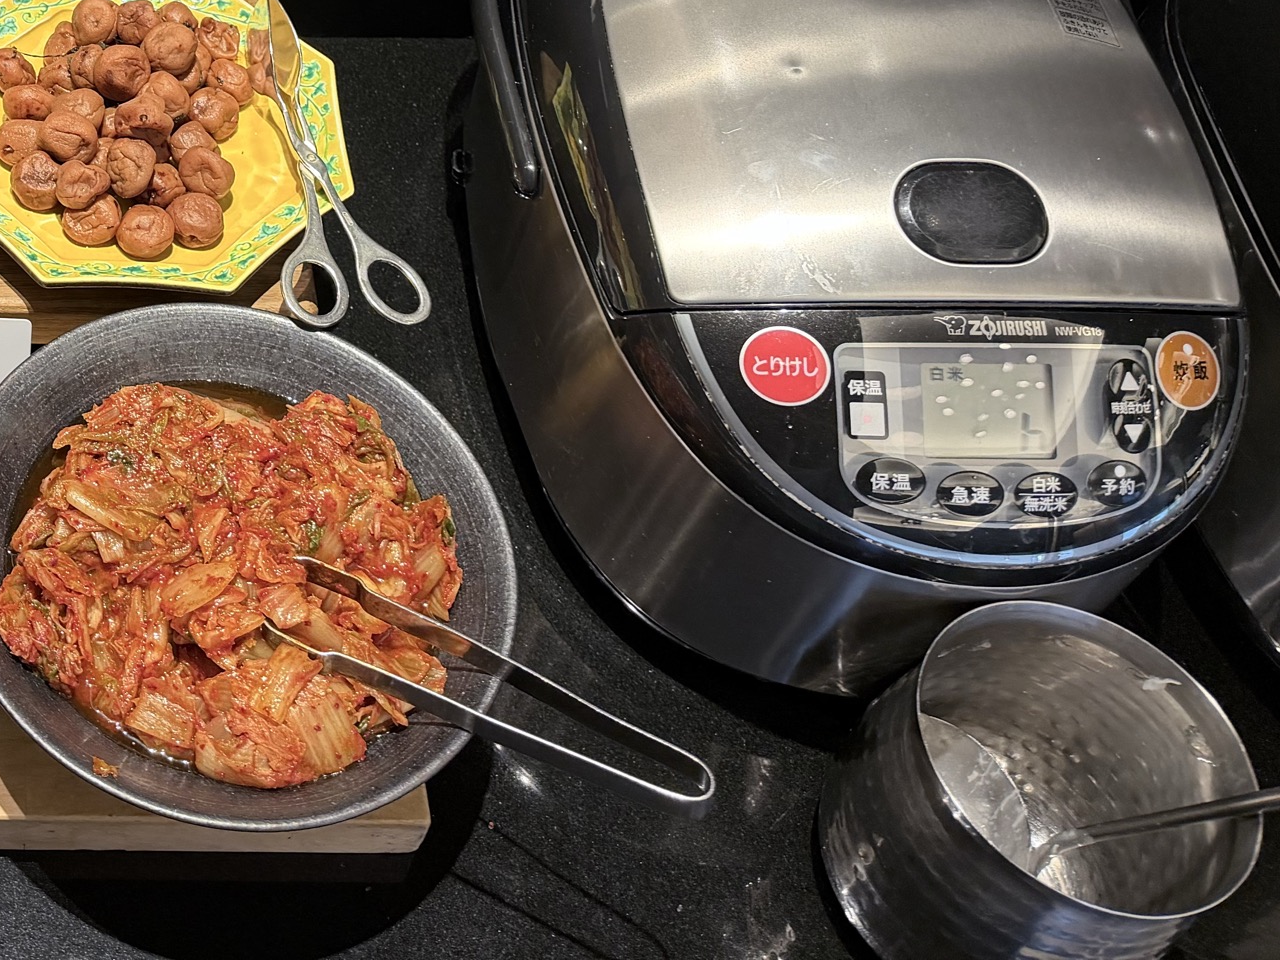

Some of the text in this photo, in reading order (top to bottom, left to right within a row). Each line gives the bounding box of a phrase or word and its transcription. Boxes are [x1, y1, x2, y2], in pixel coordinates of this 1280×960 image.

[969, 318, 1048, 339] ZOJIRUSHI
[752, 355, 819, 377] とりけし
[929, 366, 964, 382] 白米
[1173, 360, 1209, 381] 炊飯
[847, 380, 883, 396] 保温
[870, 473, 911, 491] 保温
[1032, 476, 1062, 493] 白米
[1100, 478, 1137, 496] 予約
[950, 486, 991, 504] 急速
[1024, 495, 1068, 513] 無洗米
